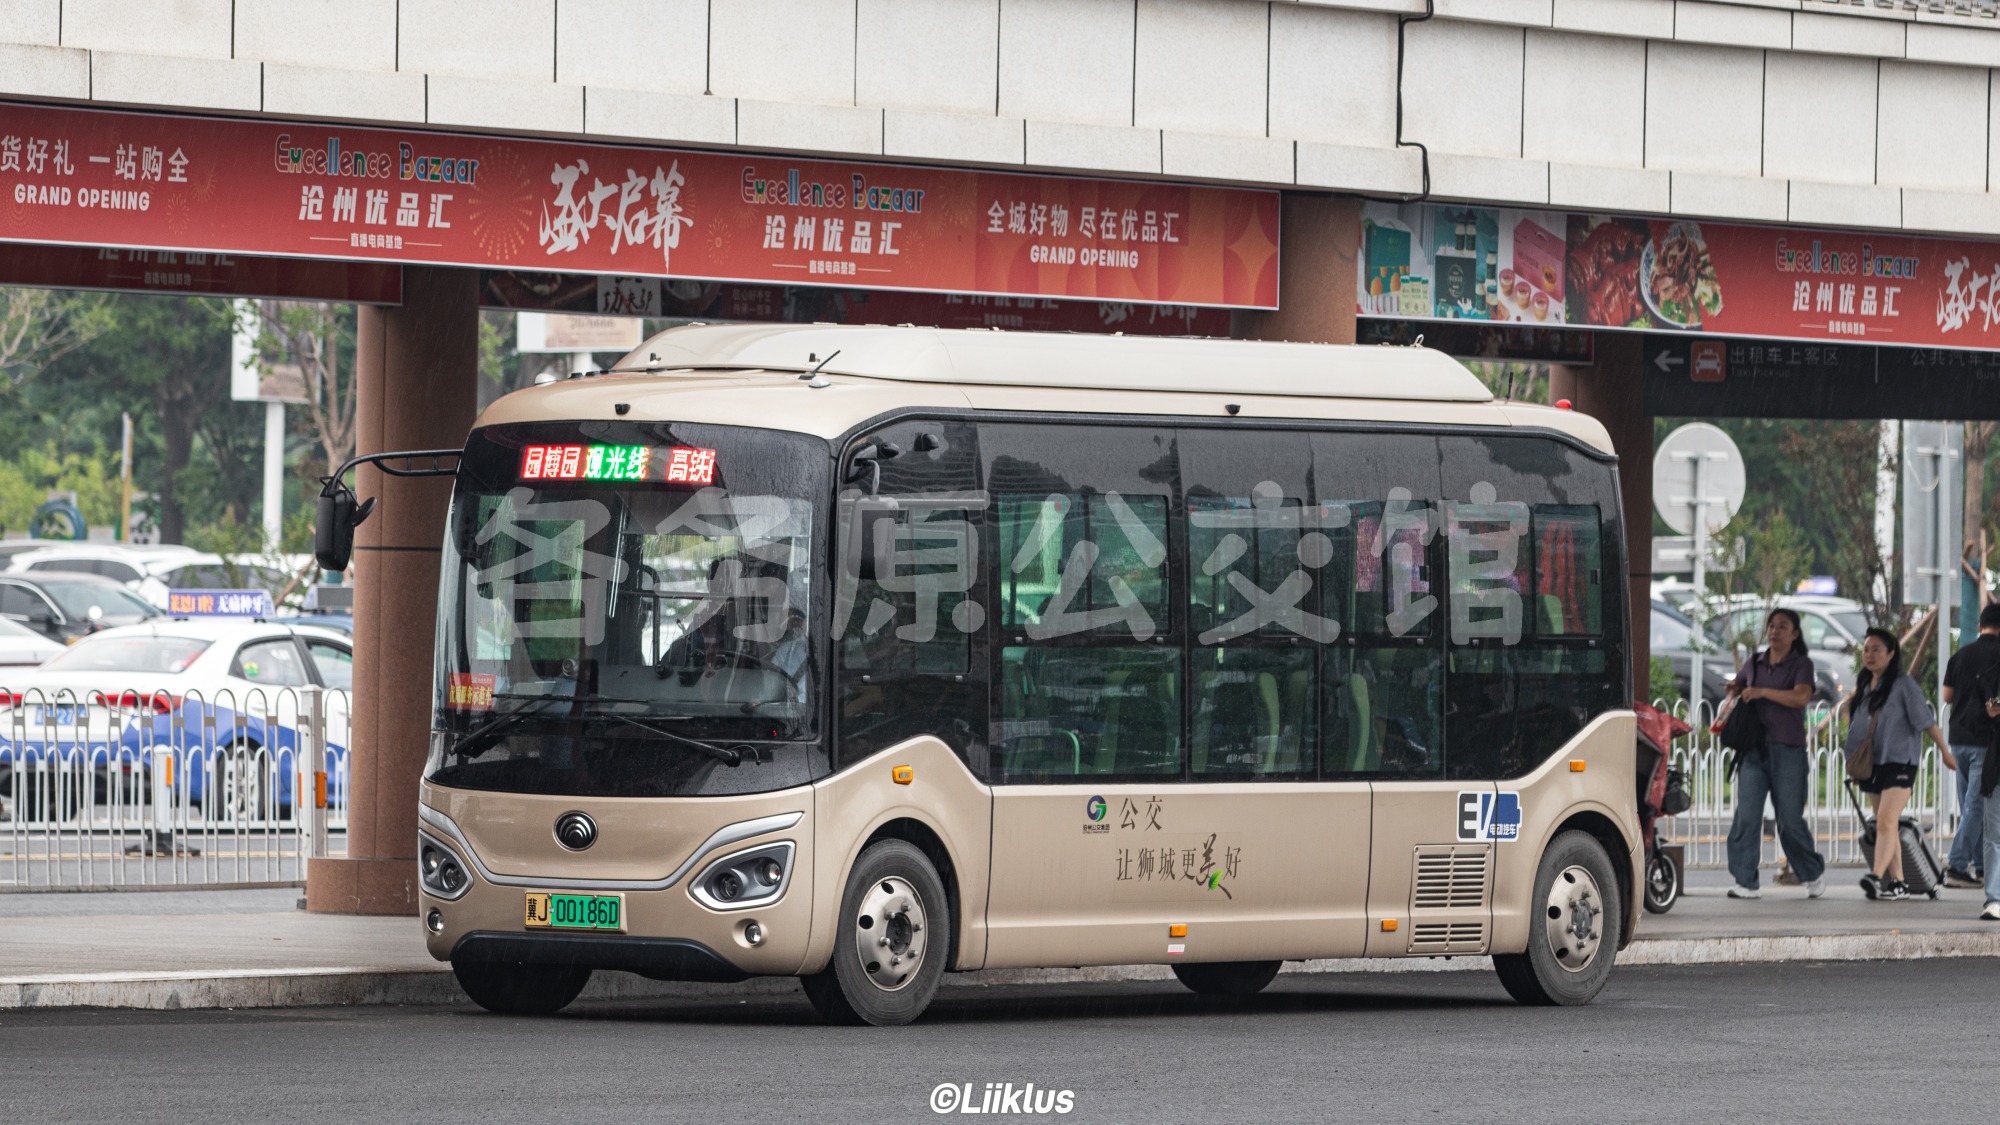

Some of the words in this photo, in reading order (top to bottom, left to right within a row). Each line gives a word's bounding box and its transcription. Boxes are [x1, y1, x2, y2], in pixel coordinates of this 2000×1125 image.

[0, 135, 75, 177] 货好礼
[89, 143, 190, 184] 一站购全
[275, 133, 391, 179] Excellence
[399, 142, 480, 185] Bazaar
[14, 183, 72, 207] GRAND
[77, 187, 151, 212] OPENING
[299, 185, 454, 230] 沧州优品汇
[741, 166, 847, 208] Excellence
[852, 173, 926, 215] Bazaar
[539, 158, 694, 275] 盛大启幕
[762, 215, 903, 256] 沧州优品汇
[987, 200, 1070, 238] 全城好物
[1079, 206, 1181, 244] 尽在优品汇
[349, 232, 404, 250] 直播电商基地
[1030, 244, 1076, 266] GRAND
[1080, 248, 1140, 270] OPENING
[1775, 238, 1858, 276] Excellence
[1862, 243, 1920, 279] Bazaar
[808, 259, 857, 277] 直播电商基地
[1793, 281, 1901, 318] 沧州优品汇
[1729, 345, 1840, 367] 出租车上客区
[668, 449, 716, 482] 高铁
[1119, 795, 1163, 832] 公交
[1489, 824, 1517, 836] 电动汽车
[1115, 833, 1242, 900] 让狮城更美好
